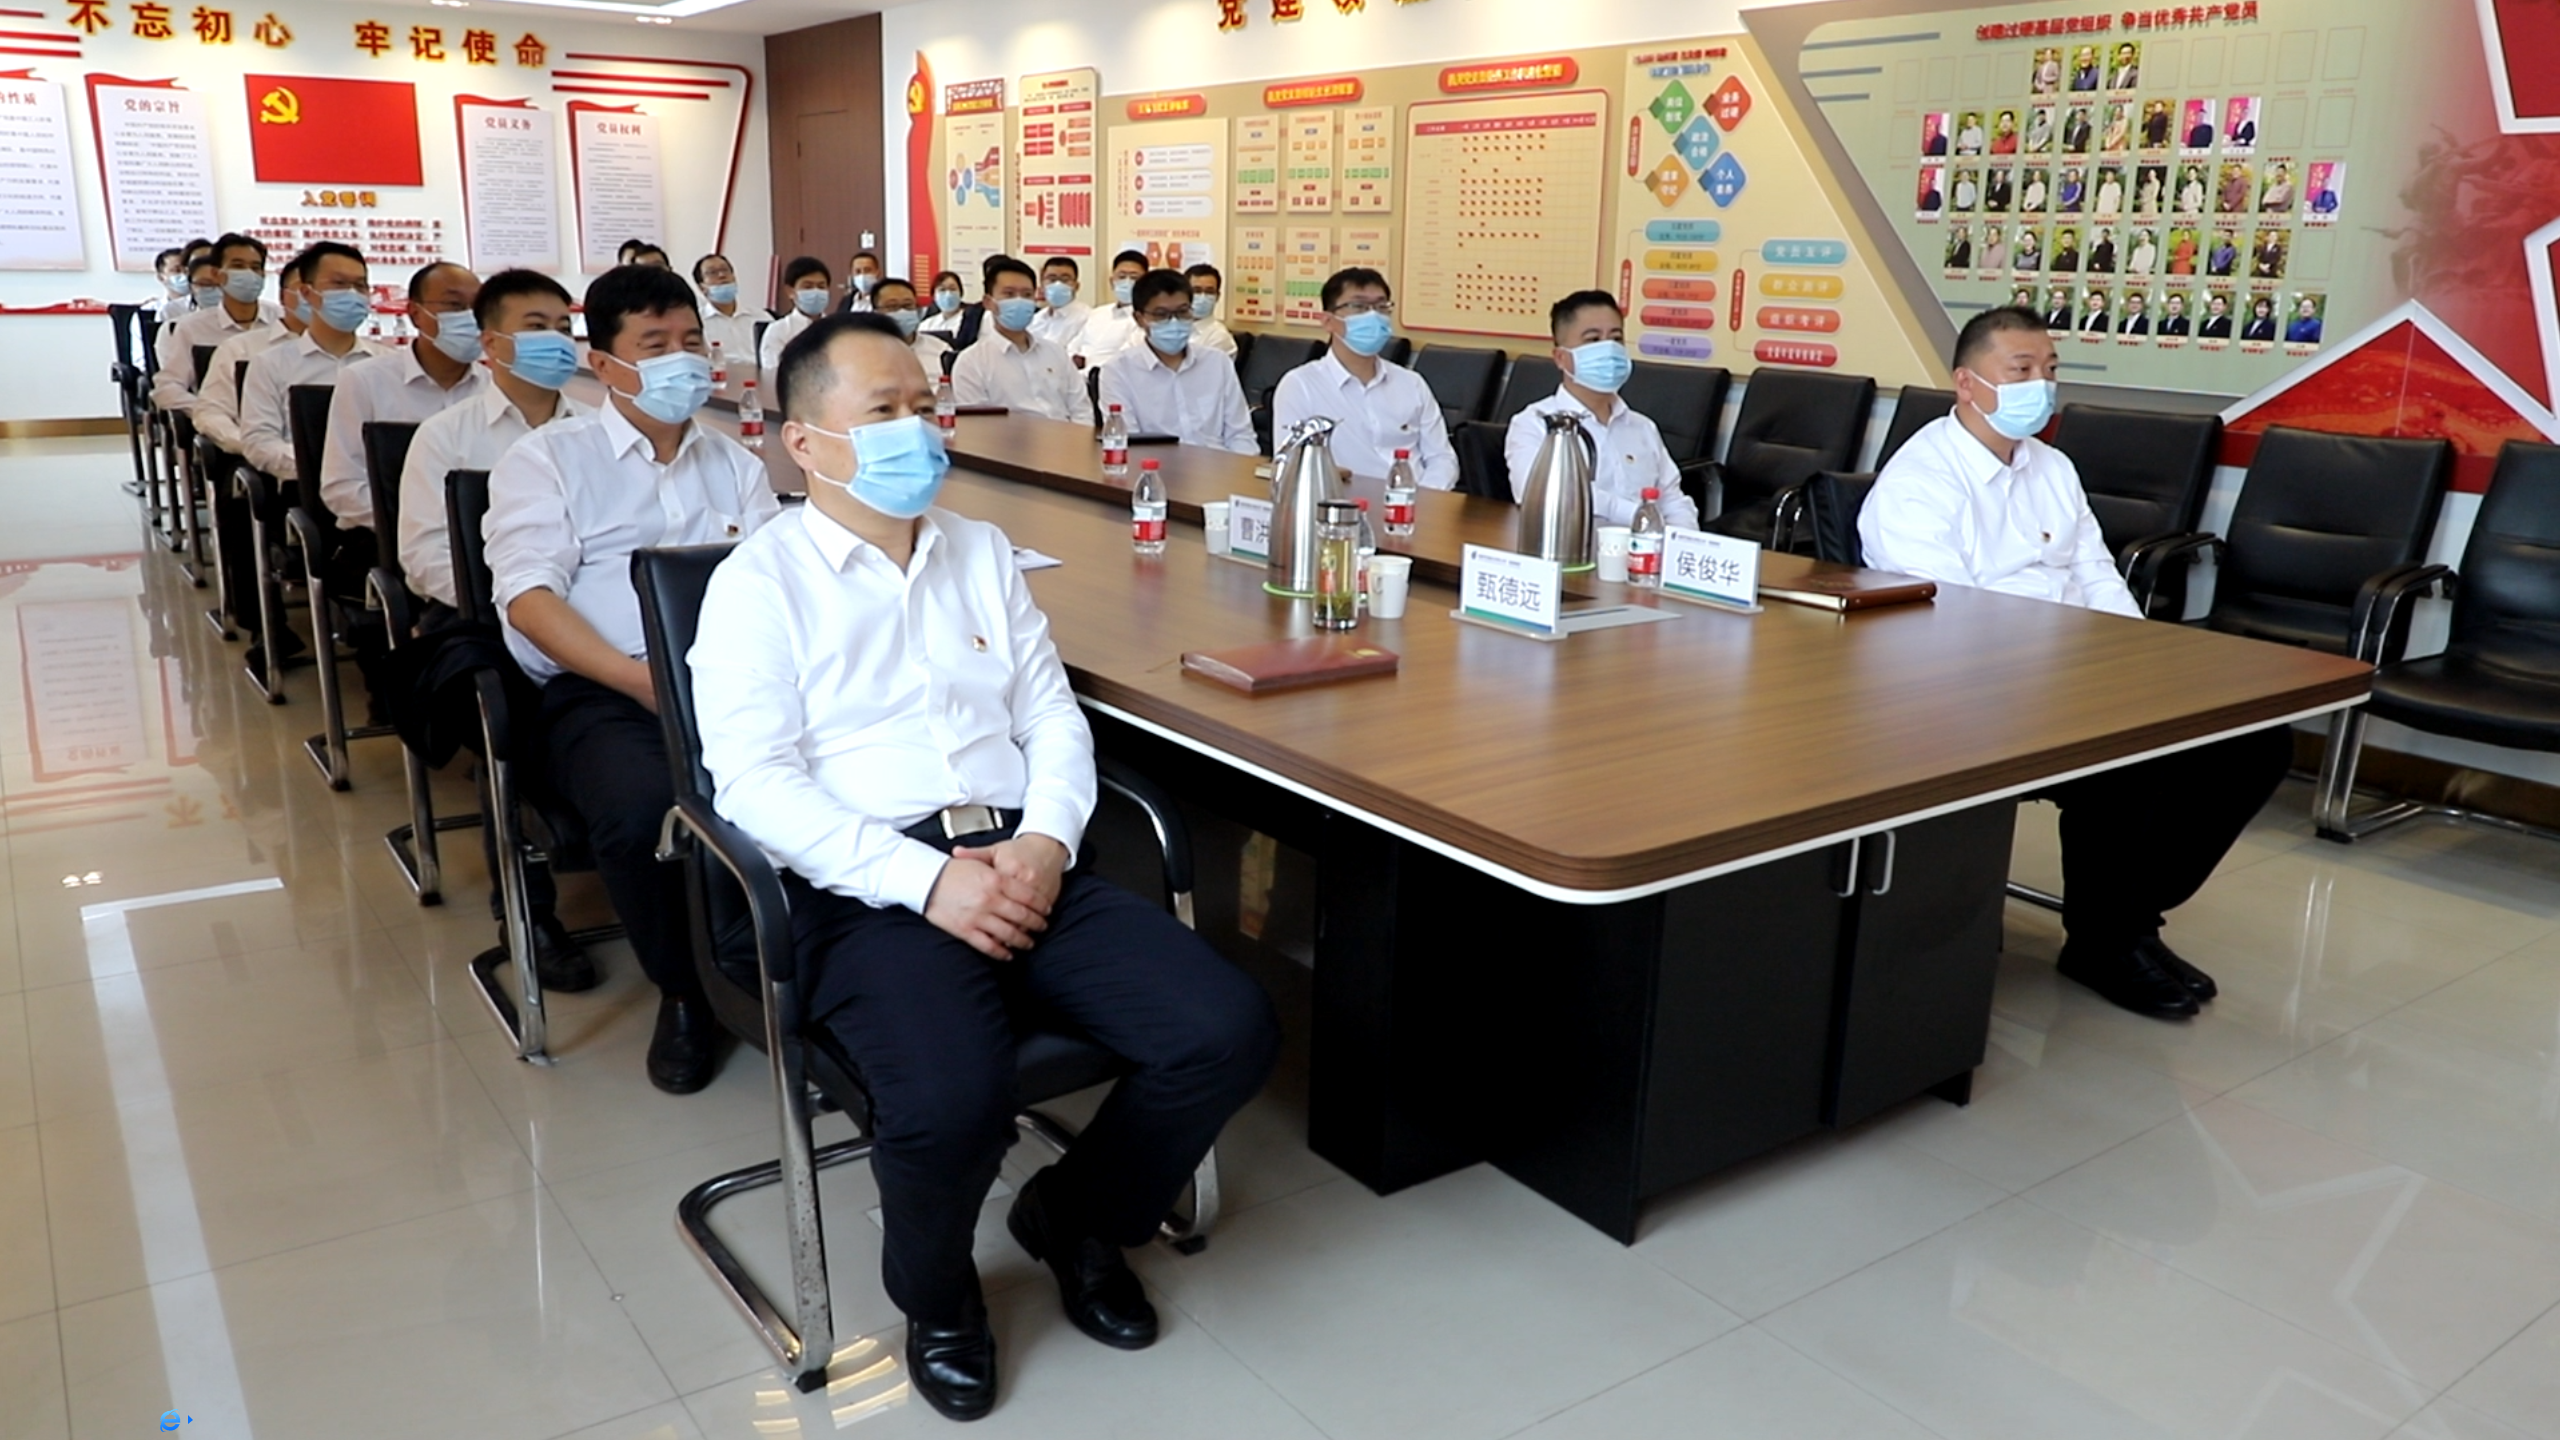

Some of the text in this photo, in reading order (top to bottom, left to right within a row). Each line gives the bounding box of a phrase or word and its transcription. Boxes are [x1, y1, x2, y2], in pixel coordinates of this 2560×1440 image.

[2121, 1, 2258, 30] 争当优秀共产党员
[66, 0, 547, 68] 不忘初心 牢记使命
[124, 98, 180, 113] 党的宗旨
[485, 116, 532, 131] 党员义务
[596, 122, 642, 136] 党员权利
[1676, 550, 1740, 587] 侯俊华
[1476, 571, 1541, 612] 甄德远
